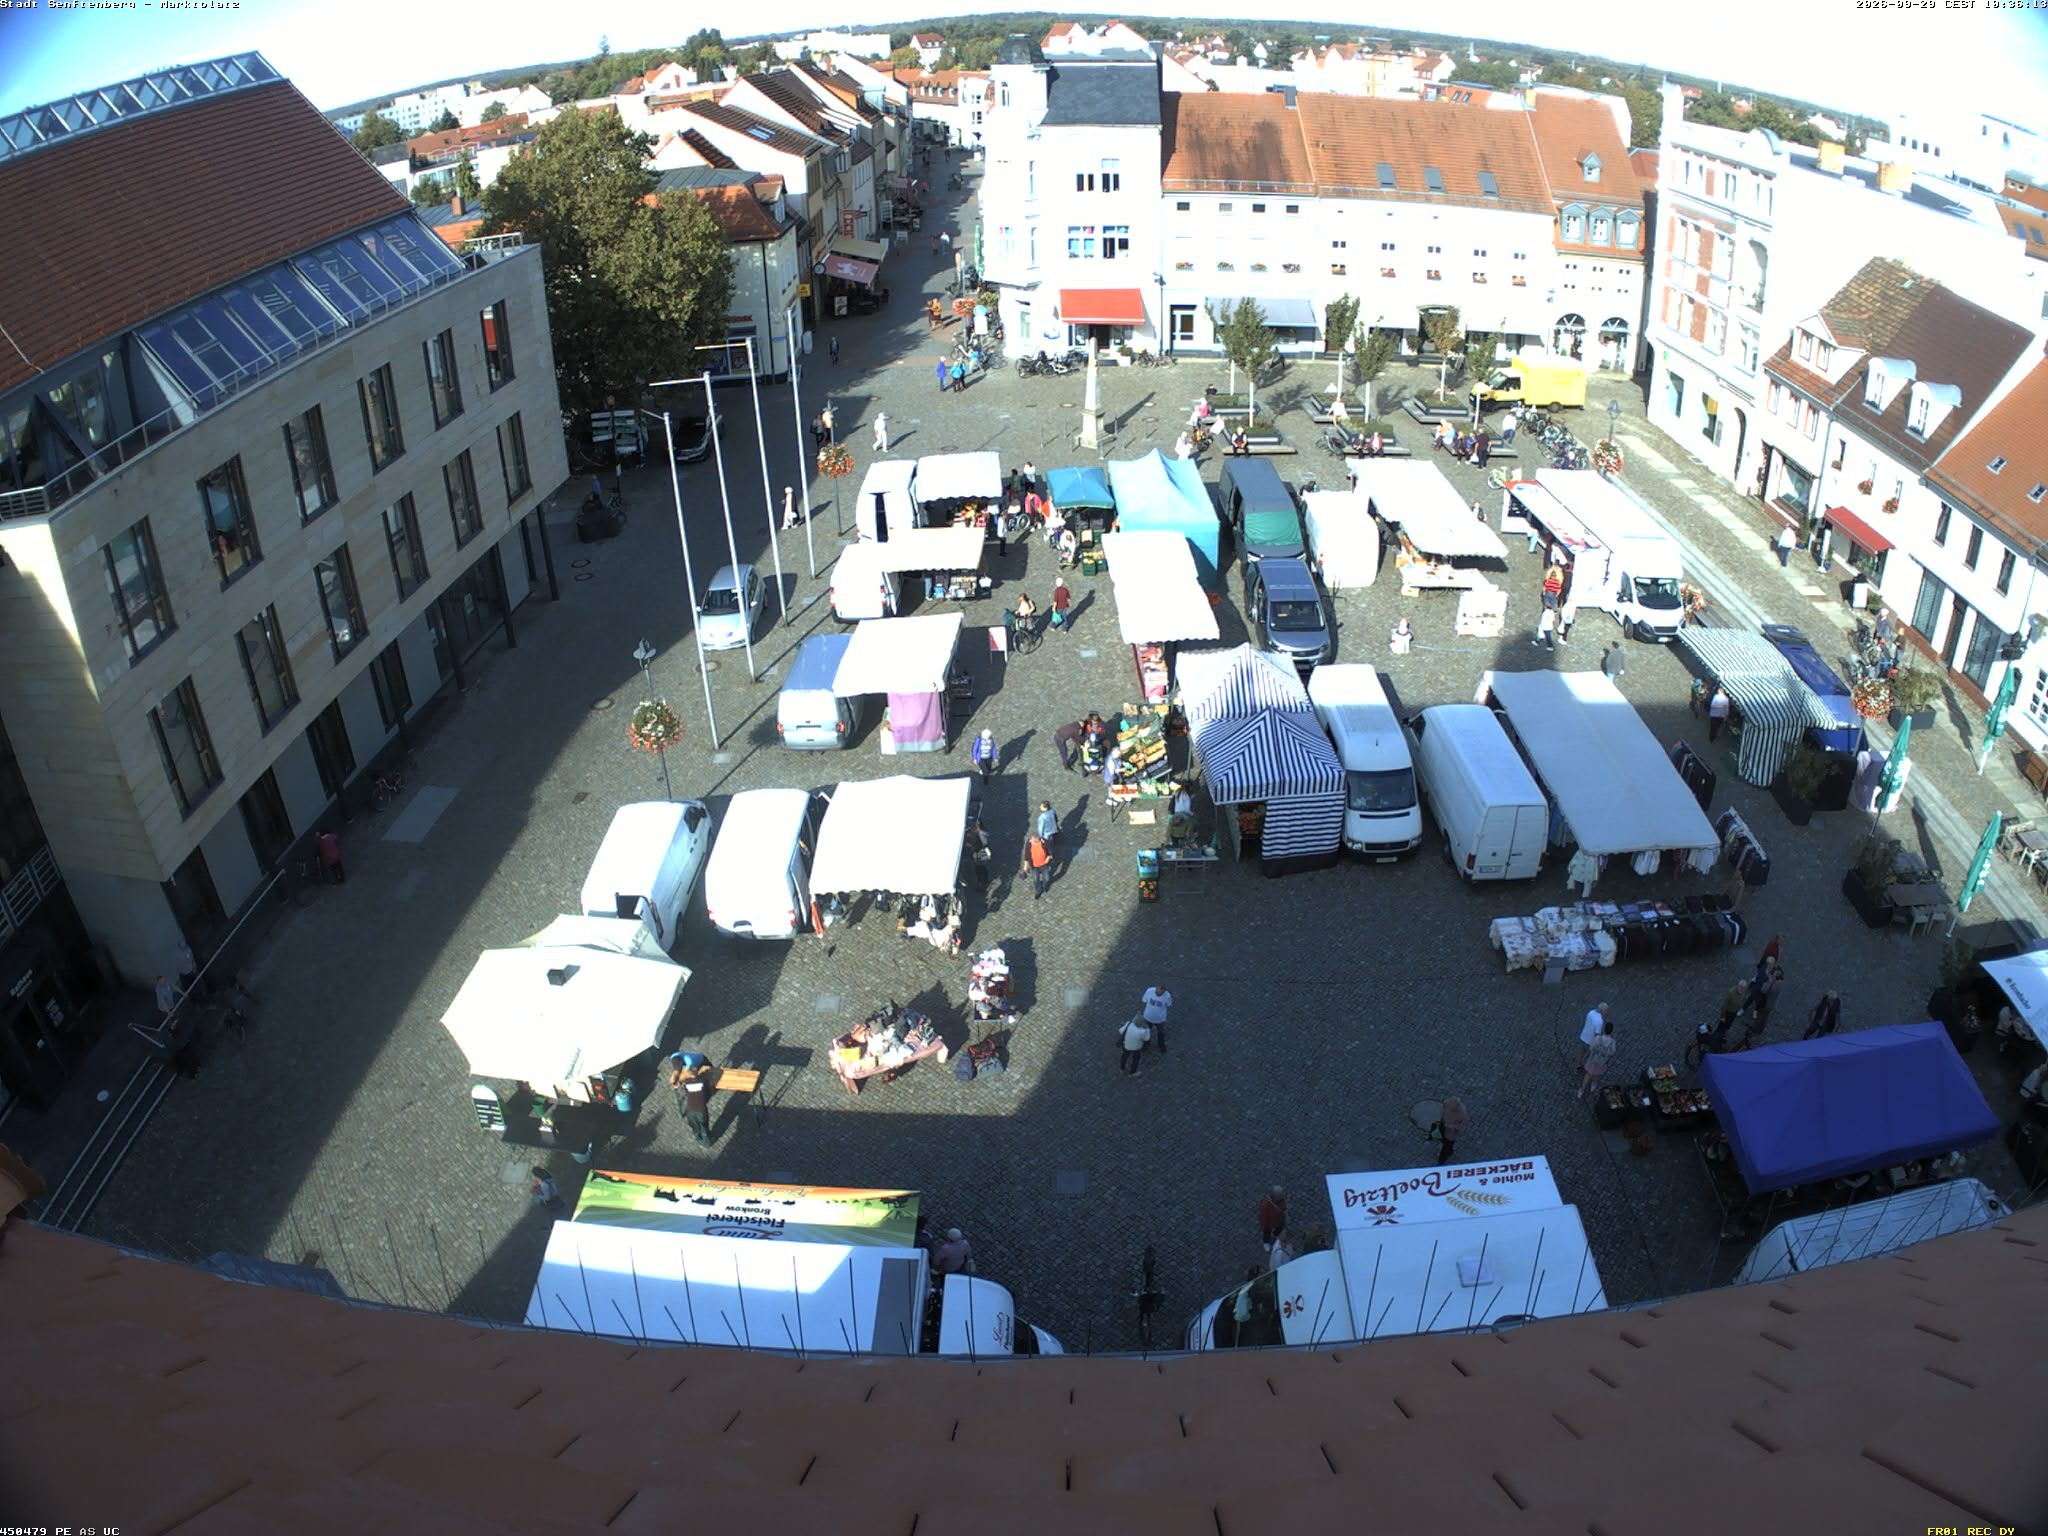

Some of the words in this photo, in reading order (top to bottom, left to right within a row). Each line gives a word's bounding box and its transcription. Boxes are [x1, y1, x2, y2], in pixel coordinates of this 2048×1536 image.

[1446, 1161, 1534, 1179] BÄCKEREI
[1478, 1178, 1489, 1186] &
[1492, 1171, 1535, 1185] Mühle
[1343, 1171, 1461, 1208] Boeltzig
[724, 1205, 772, 1216] Bronkow
[705, 1212, 786, 1229] Fleischerei
